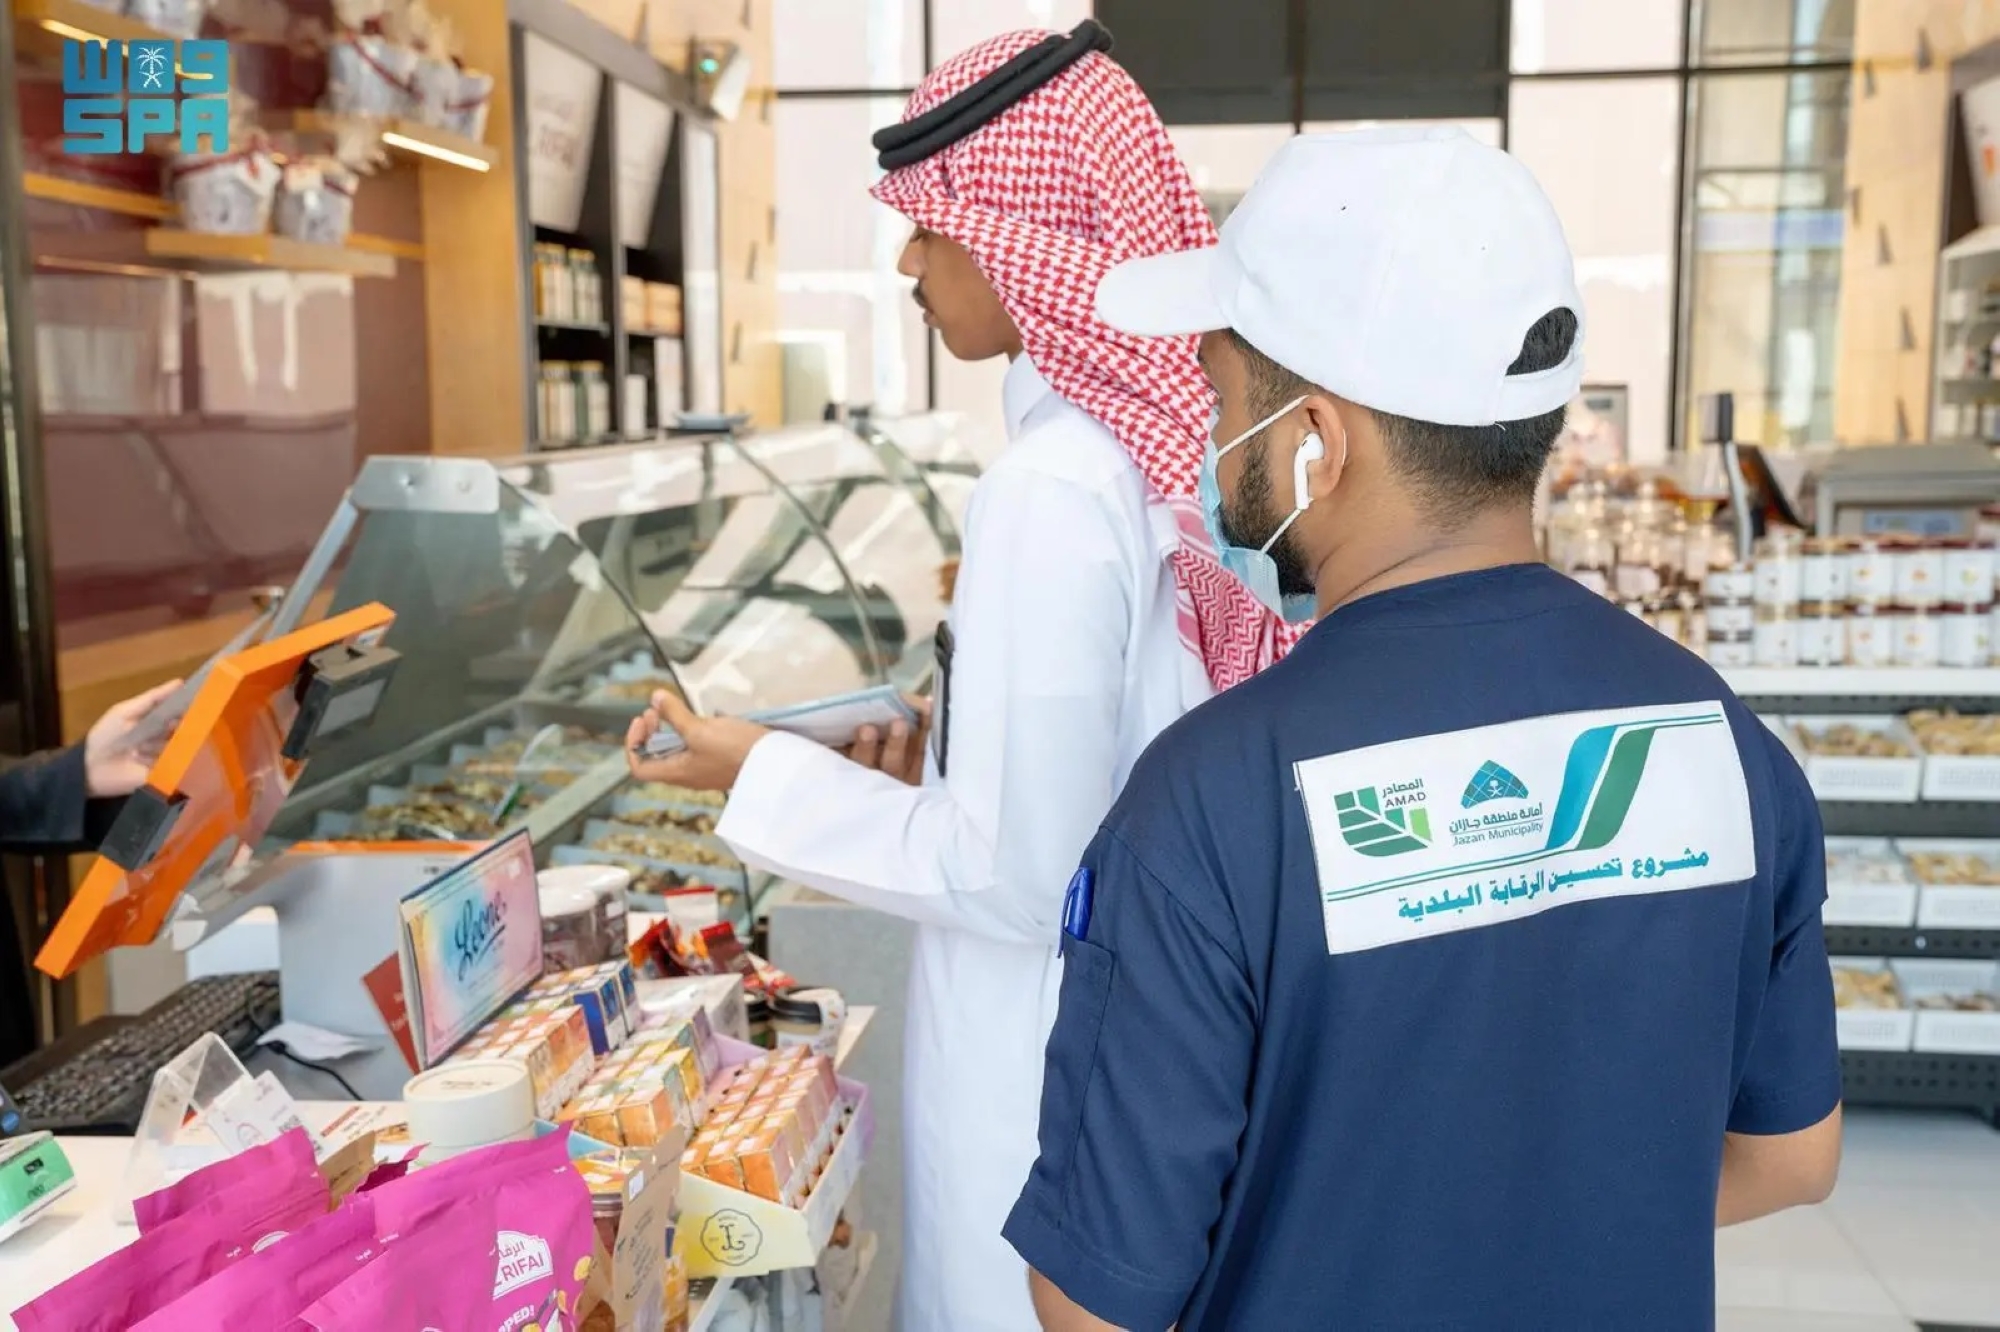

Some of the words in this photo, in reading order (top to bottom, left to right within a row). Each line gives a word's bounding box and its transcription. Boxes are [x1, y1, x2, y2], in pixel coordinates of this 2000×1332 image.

[1382, 778, 1424, 798] المصادر
[1385, 791, 1426, 808] AMAD
[1519, 802, 1543, 819] أمانة
[1450, 816, 1480, 834] جازان
[1453, 833, 1486, 846] Jazan
[1488, 821, 1544, 841] Municipality
[1548, 856, 1623, 893] تحسين
[1631, 847, 1710, 879] مشروع
[1490, 869, 1545, 904] الرقابة
[1398, 882, 1482, 922] البلدية
